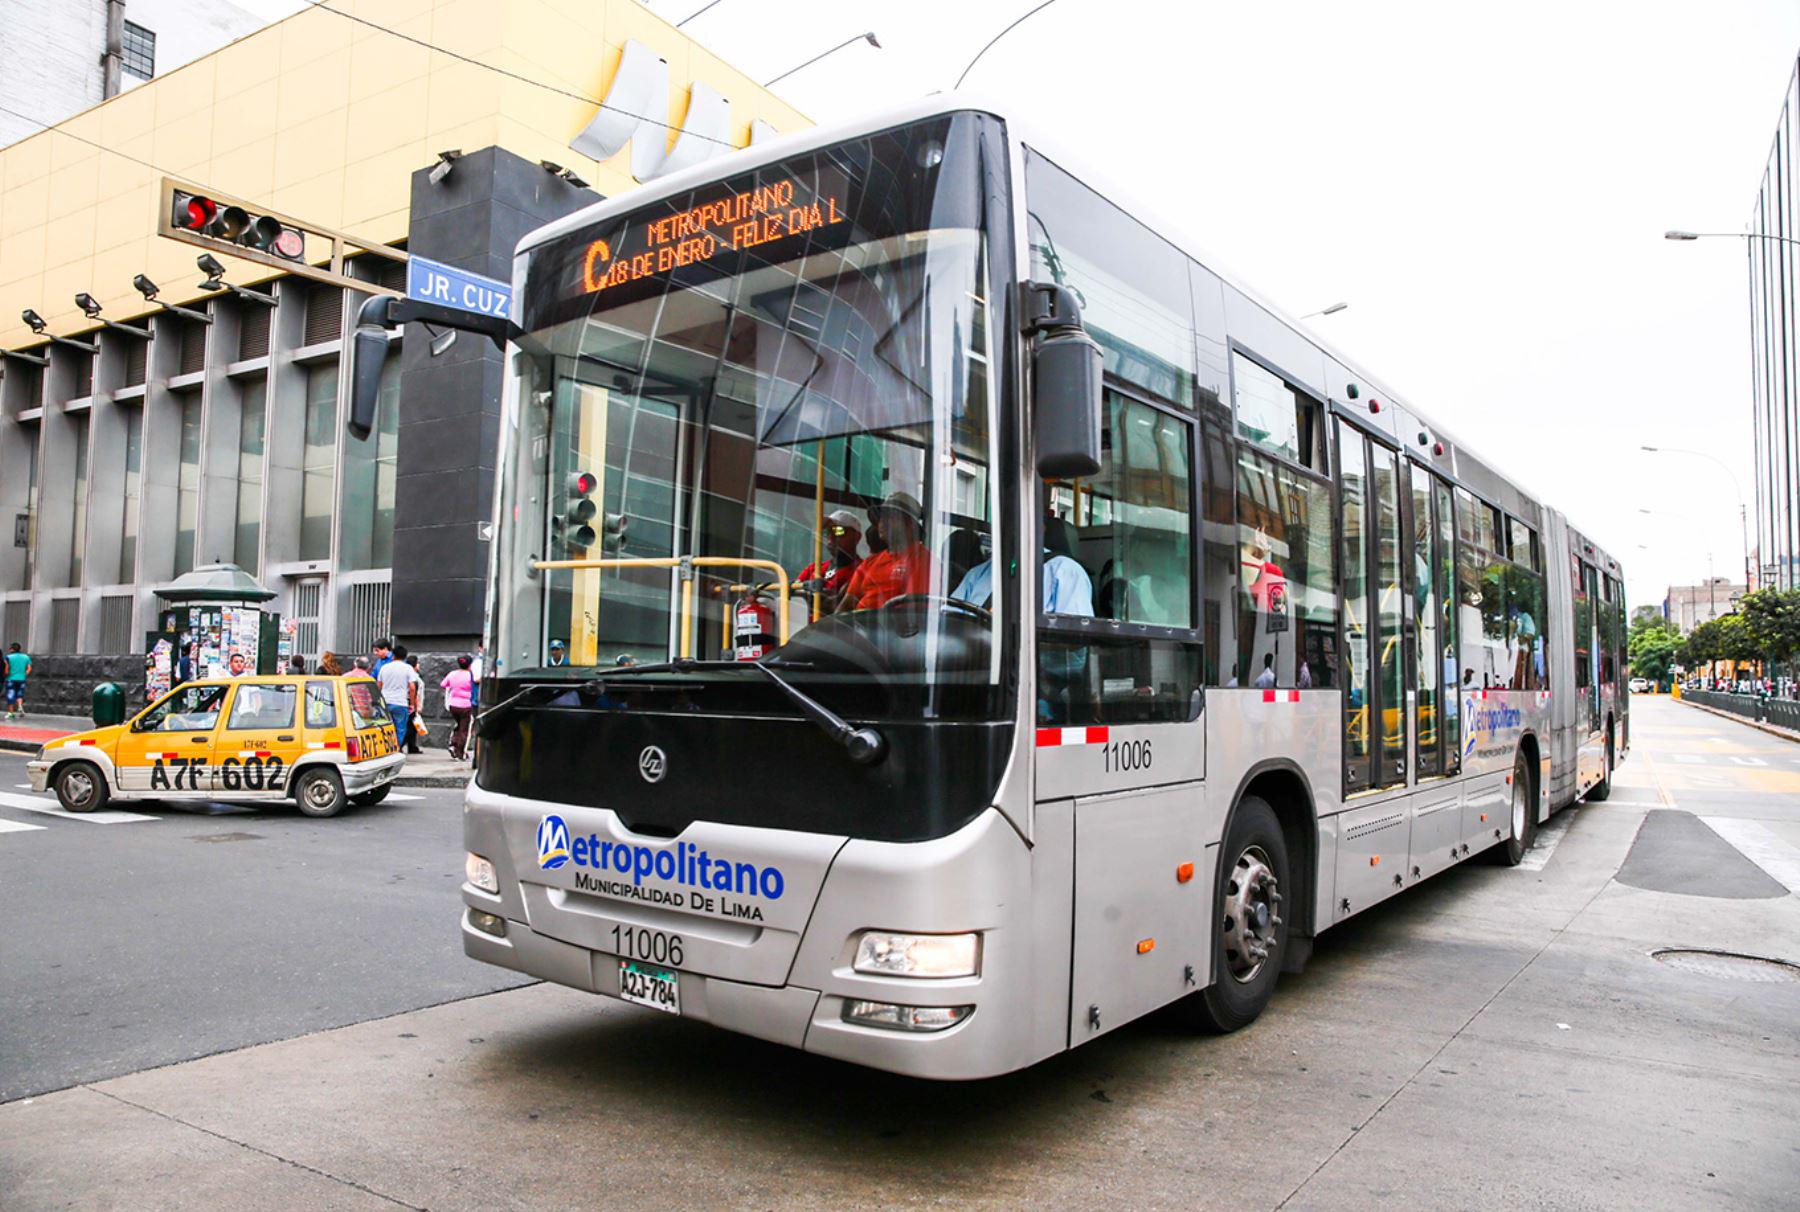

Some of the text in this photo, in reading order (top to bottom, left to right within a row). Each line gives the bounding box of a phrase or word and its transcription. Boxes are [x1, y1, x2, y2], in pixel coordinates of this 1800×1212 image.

[647, 180, 793, 247] METROPOLITANO
[584, 239, 611, 293] C
[608, 261, 629, 287] 18
[632, 252, 655, 280] DE
[659, 234, 715, 272] ENERO
[733, 214, 783, 250] FELIZ
[788, 202, 822, 236] DIA
[829, 197, 842, 224] L
[420, 272, 508, 317] JR. CUZ
[1102, 739, 1152, 773] 11006
[537, 814, 784, 900] Metropolitano
[611, 924, 684, 967] 11006
[621, 970, 676, 1007] A2J-784
